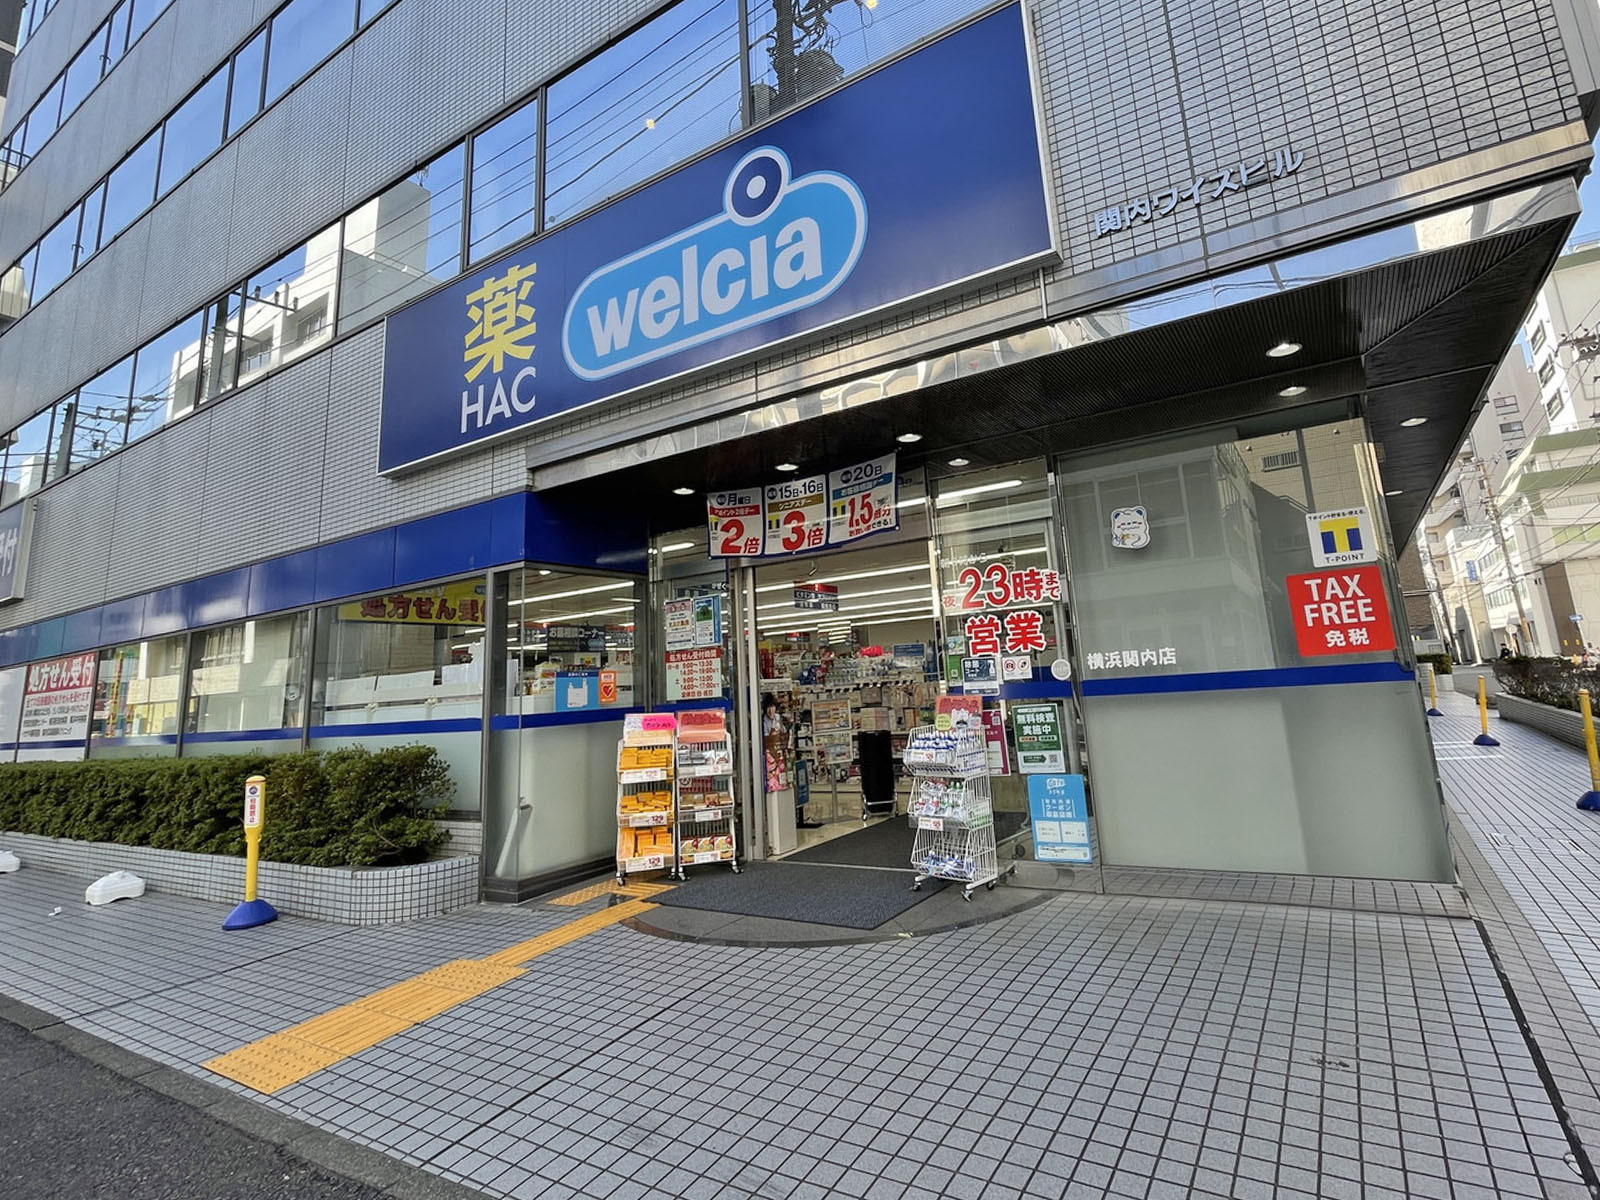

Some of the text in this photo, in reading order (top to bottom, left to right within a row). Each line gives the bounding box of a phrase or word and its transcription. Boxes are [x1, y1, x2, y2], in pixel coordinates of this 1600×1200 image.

[1094, 149, 1304, 237] 関内ワイズビル
[586, 216, 823, 357] welcia
[463, 262, 537, 383] 薬
[460, 366, 537, 433] HAC
[720, 519, 760, 554] 2倍
[782, 511, 824, 551] 3倍
[1326, 553, 1365, 563] T-POINT
[1304, 574, 1365, 602] TAX
[1304, 598, 1376, 627] FREE
[966, 612, 1045, 656] 営業
[1325, 628, 1370, 648] 免税
[27, 655, 96, 693] 処方せん受付
[1087, 647, 1177, 670] 横浜関内店
